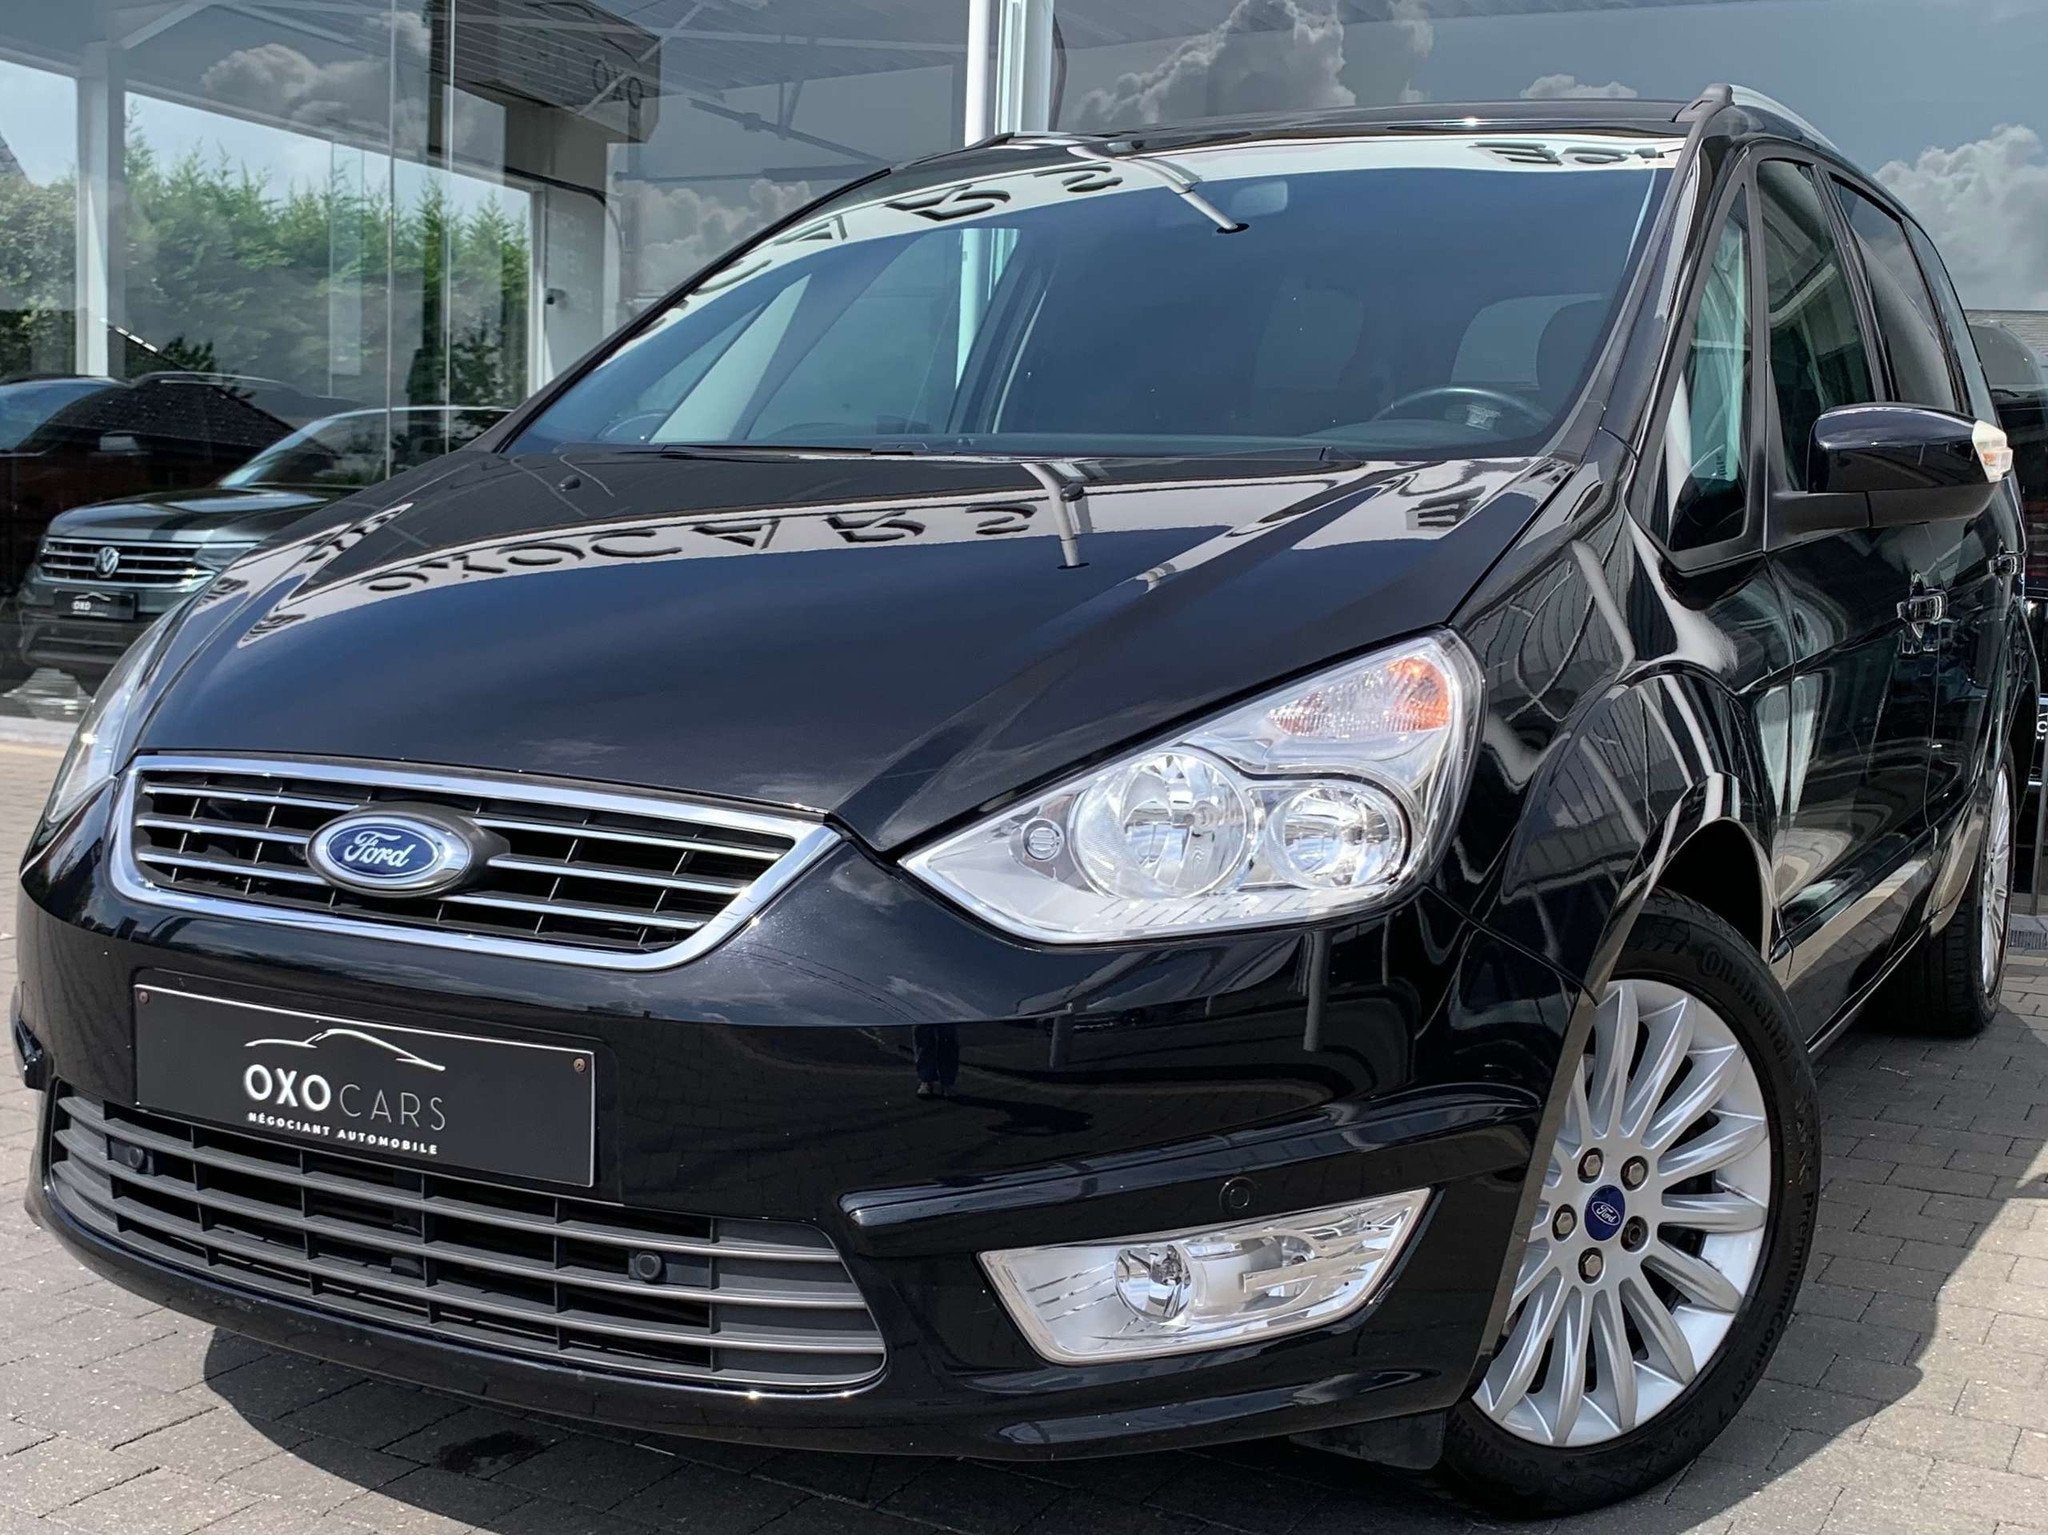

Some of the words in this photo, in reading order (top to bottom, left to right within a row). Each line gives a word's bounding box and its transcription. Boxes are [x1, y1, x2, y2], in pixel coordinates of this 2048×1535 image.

[343, 830, 417, 868] Ford
[244, 1063, 332, 1112] OXO
[339, 1083, 446, 1131] CARS
[248, 1111, 330, 1136] NÉGOCIANT
[337, 1129, 438, 1155] AUTOMOBILE
[1596, 1204, 1617, 1223] Ford
